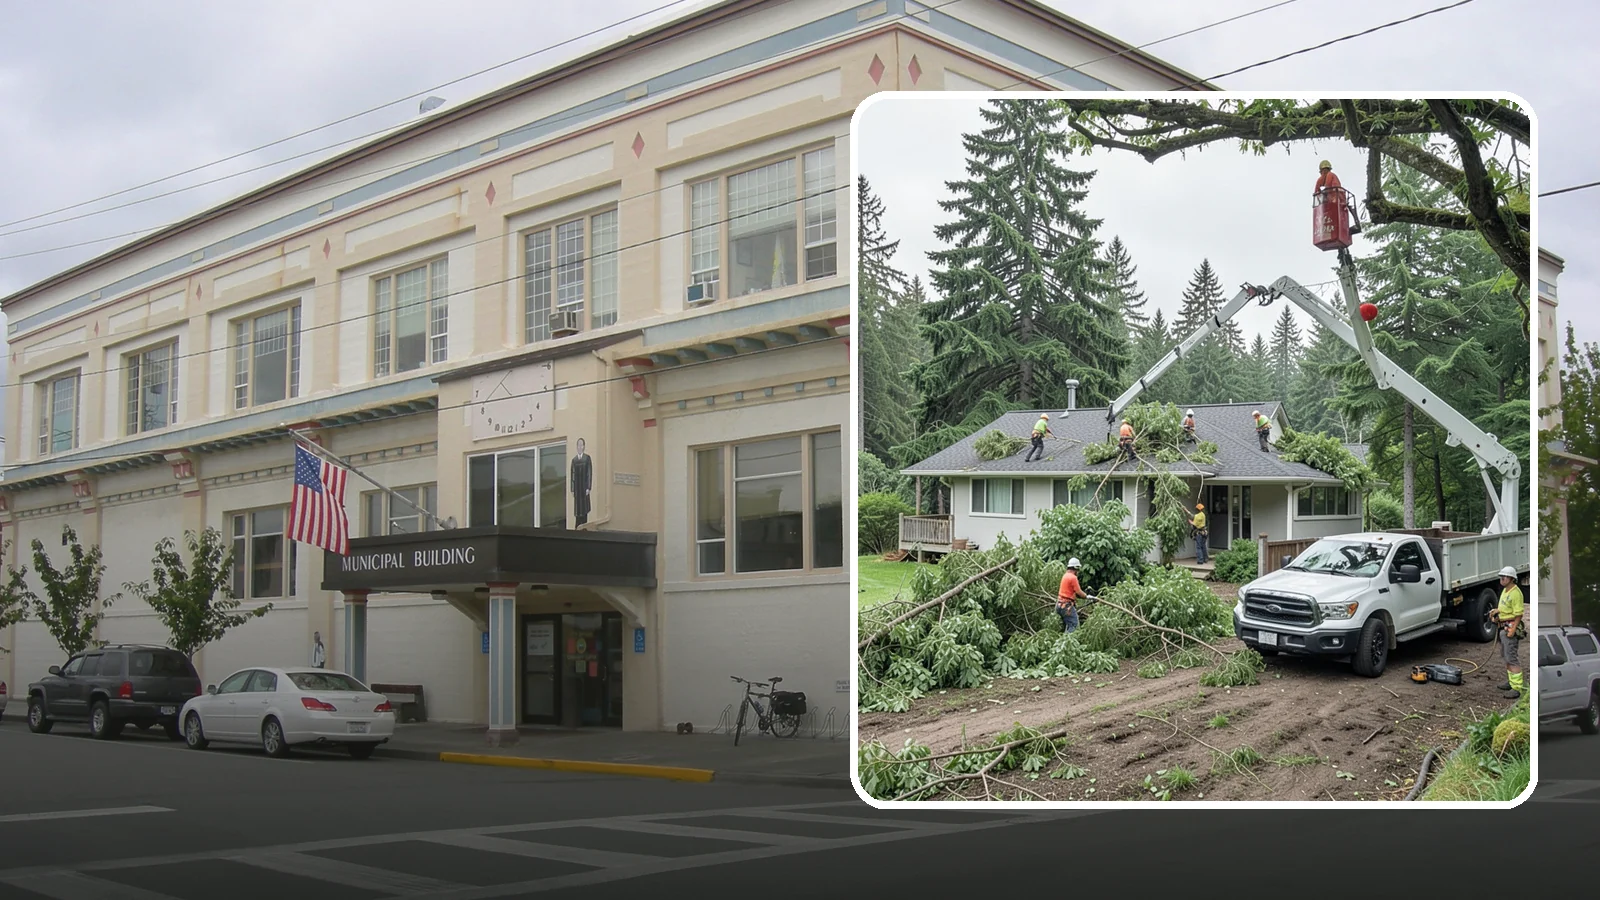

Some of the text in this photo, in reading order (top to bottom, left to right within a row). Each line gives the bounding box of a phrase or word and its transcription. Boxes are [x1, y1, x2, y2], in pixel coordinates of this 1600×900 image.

[475, 390, 479, 398] 7
[480, 407, 484, 415] 8
[488, 418, 492, 426] 9
[494, 424, 500, 432] 10
[502, 426, 506, 434] 11
[528, 414, 533, 422] 3
[536, 402, 540, 410] 4
[342, 546, 475, 572] MUNICIPAL BUILDING
